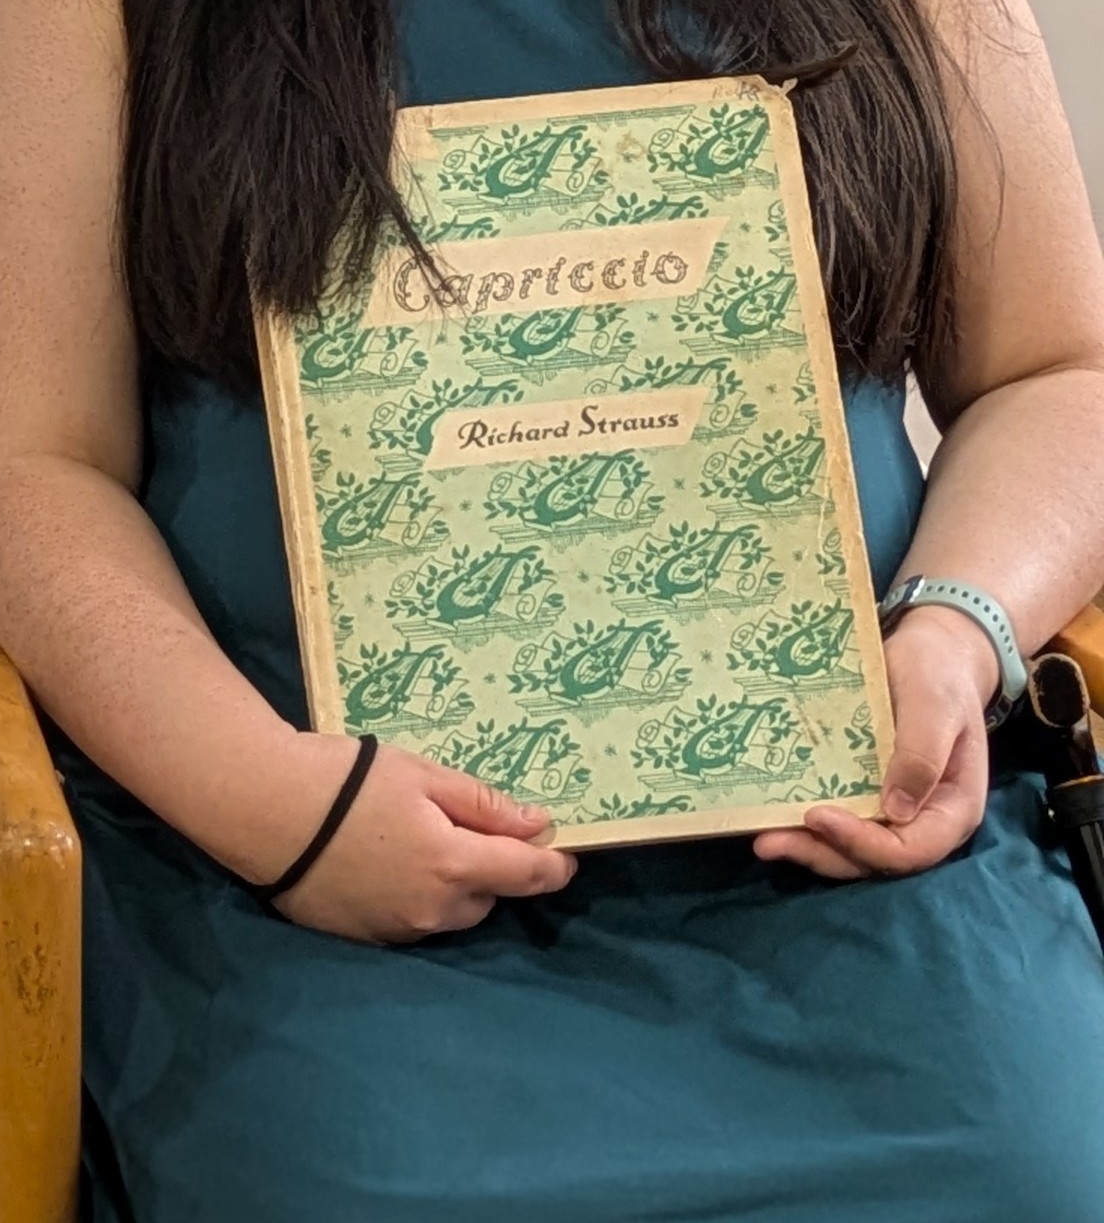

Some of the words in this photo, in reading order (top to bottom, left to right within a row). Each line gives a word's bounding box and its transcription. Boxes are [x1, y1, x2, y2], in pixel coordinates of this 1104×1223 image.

[393, 249, 688, 314] Capriccio
[458, 419, 570, 449] Richard
[578, 406, 680, 438] Strauss
